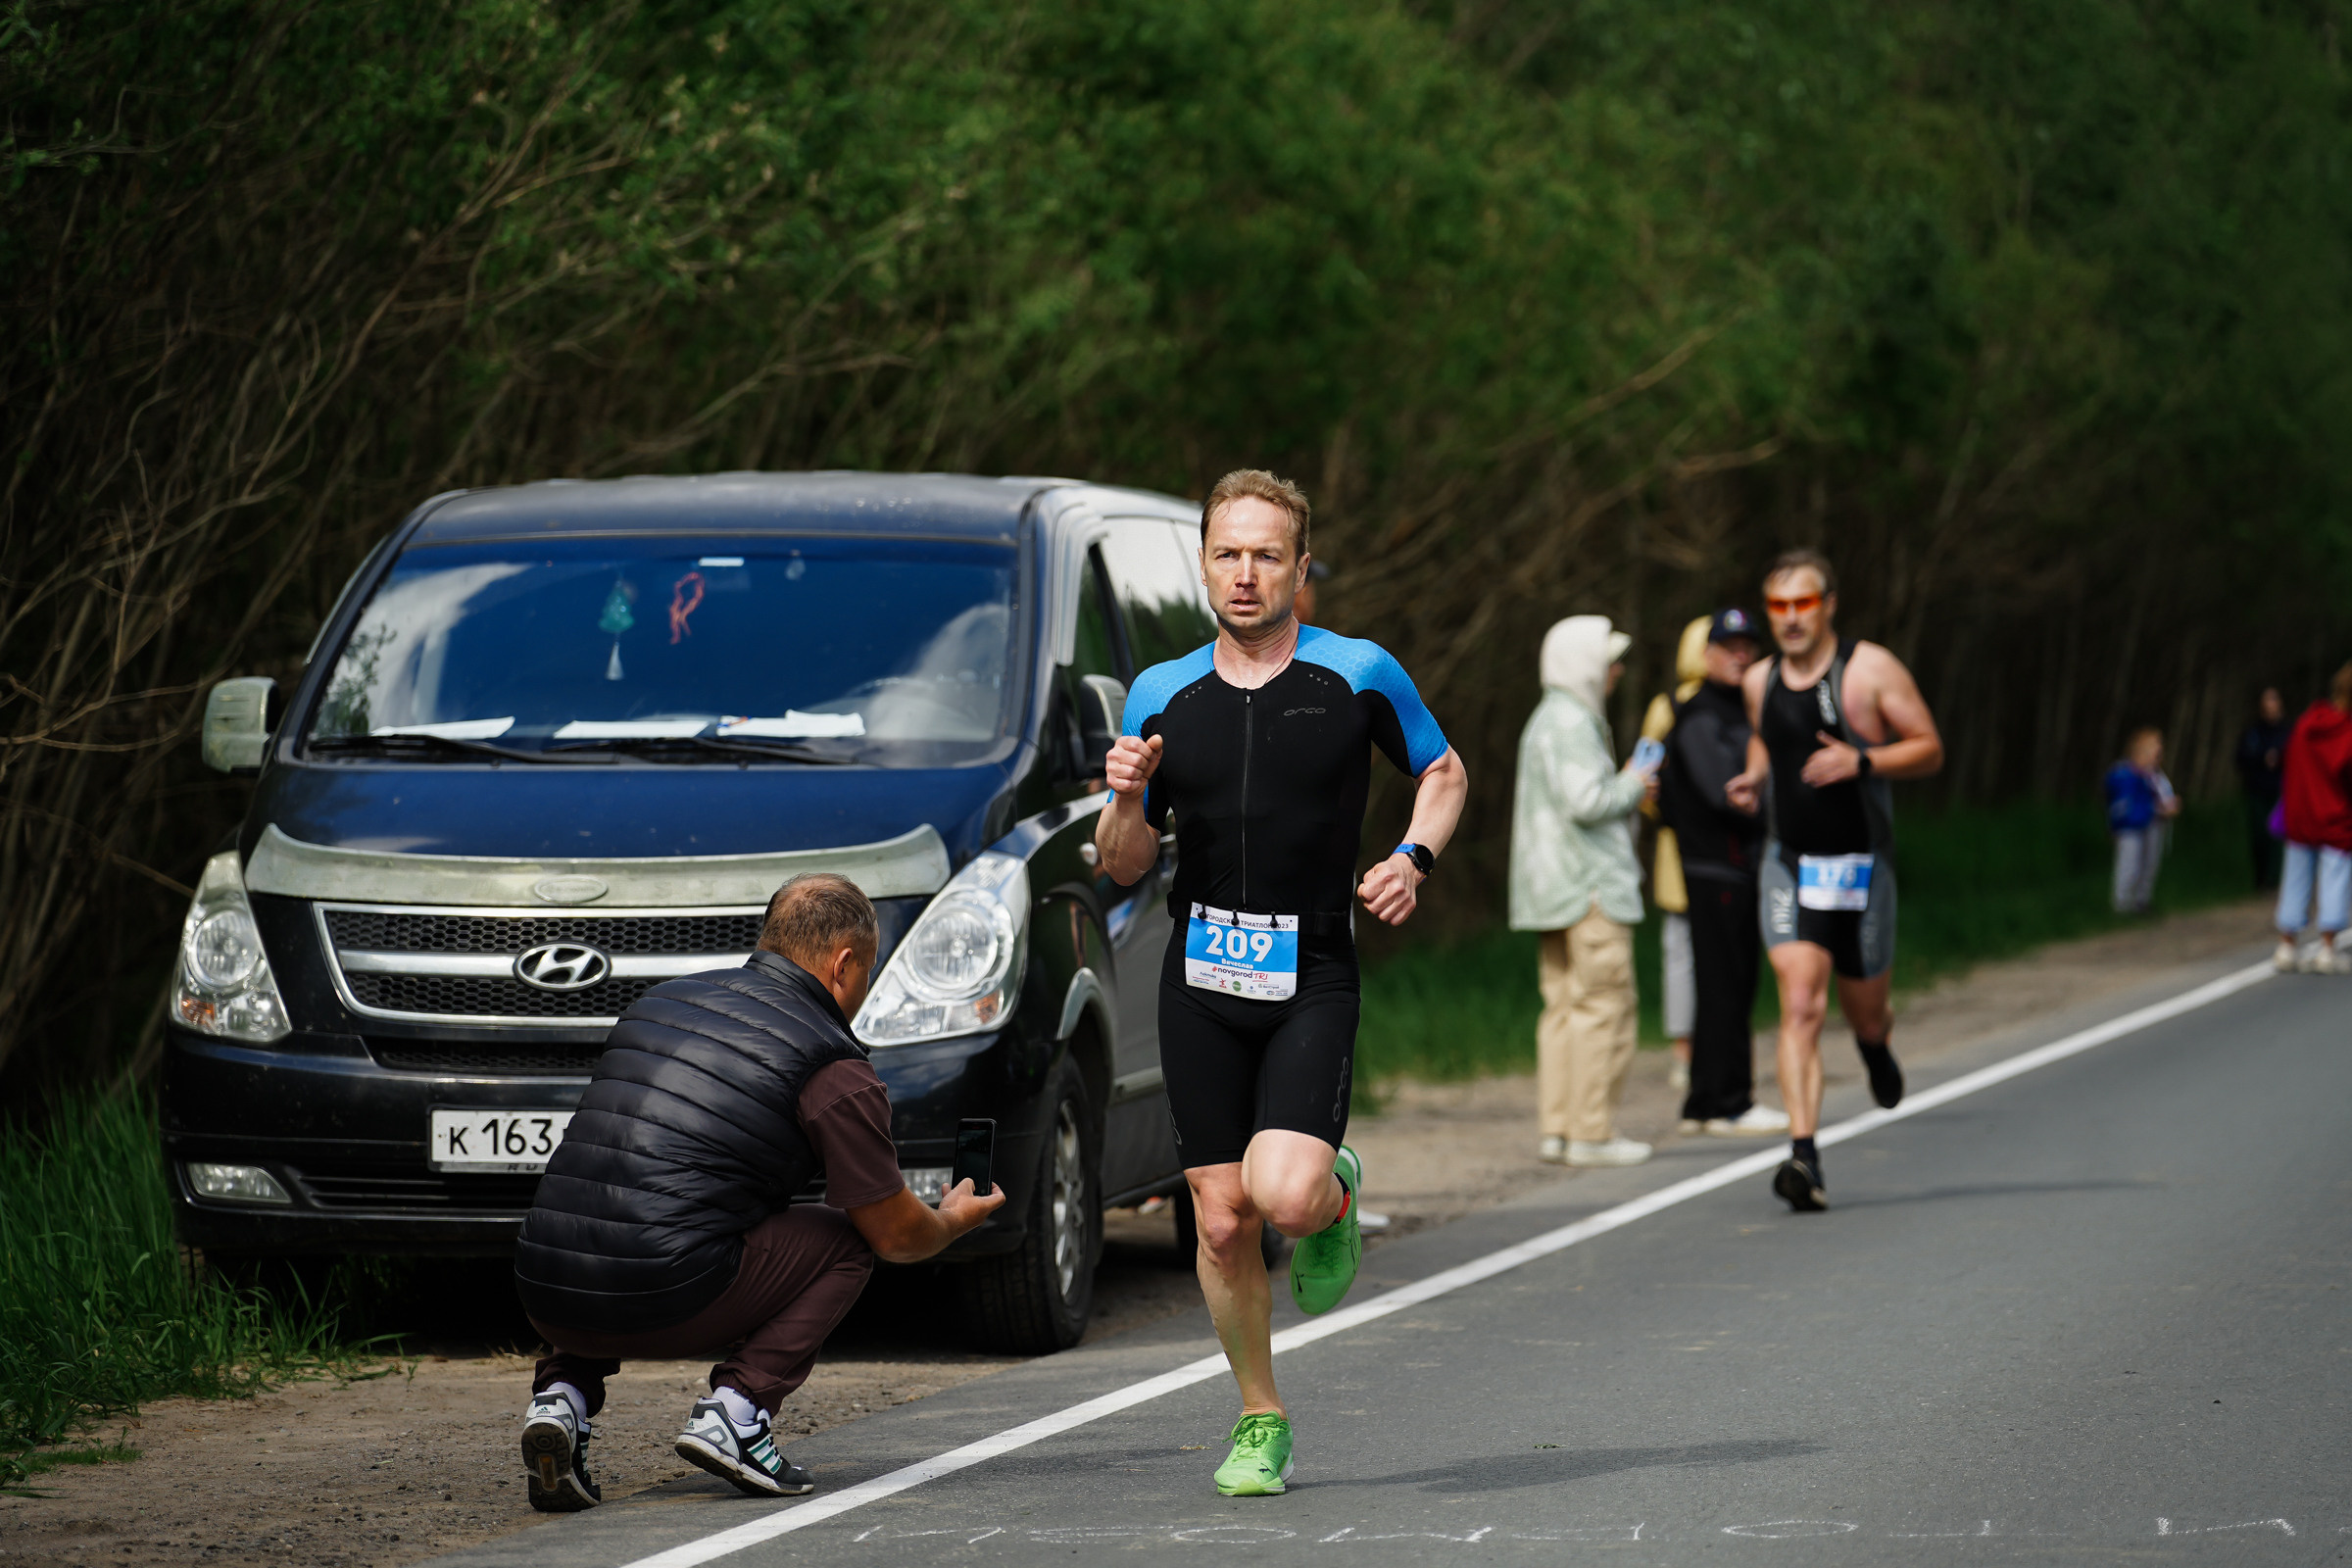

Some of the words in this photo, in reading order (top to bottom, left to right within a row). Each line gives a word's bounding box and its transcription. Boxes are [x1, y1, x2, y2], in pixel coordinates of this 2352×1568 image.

[1283, 707, 1326, 716] orca
[1205, 925, 1273, 962] 209
[1221, 957, 1254, 970] Вячеслав
[1332, 1055, 1349, 1123] orca
[481, 1117, 553, 1155] 163
